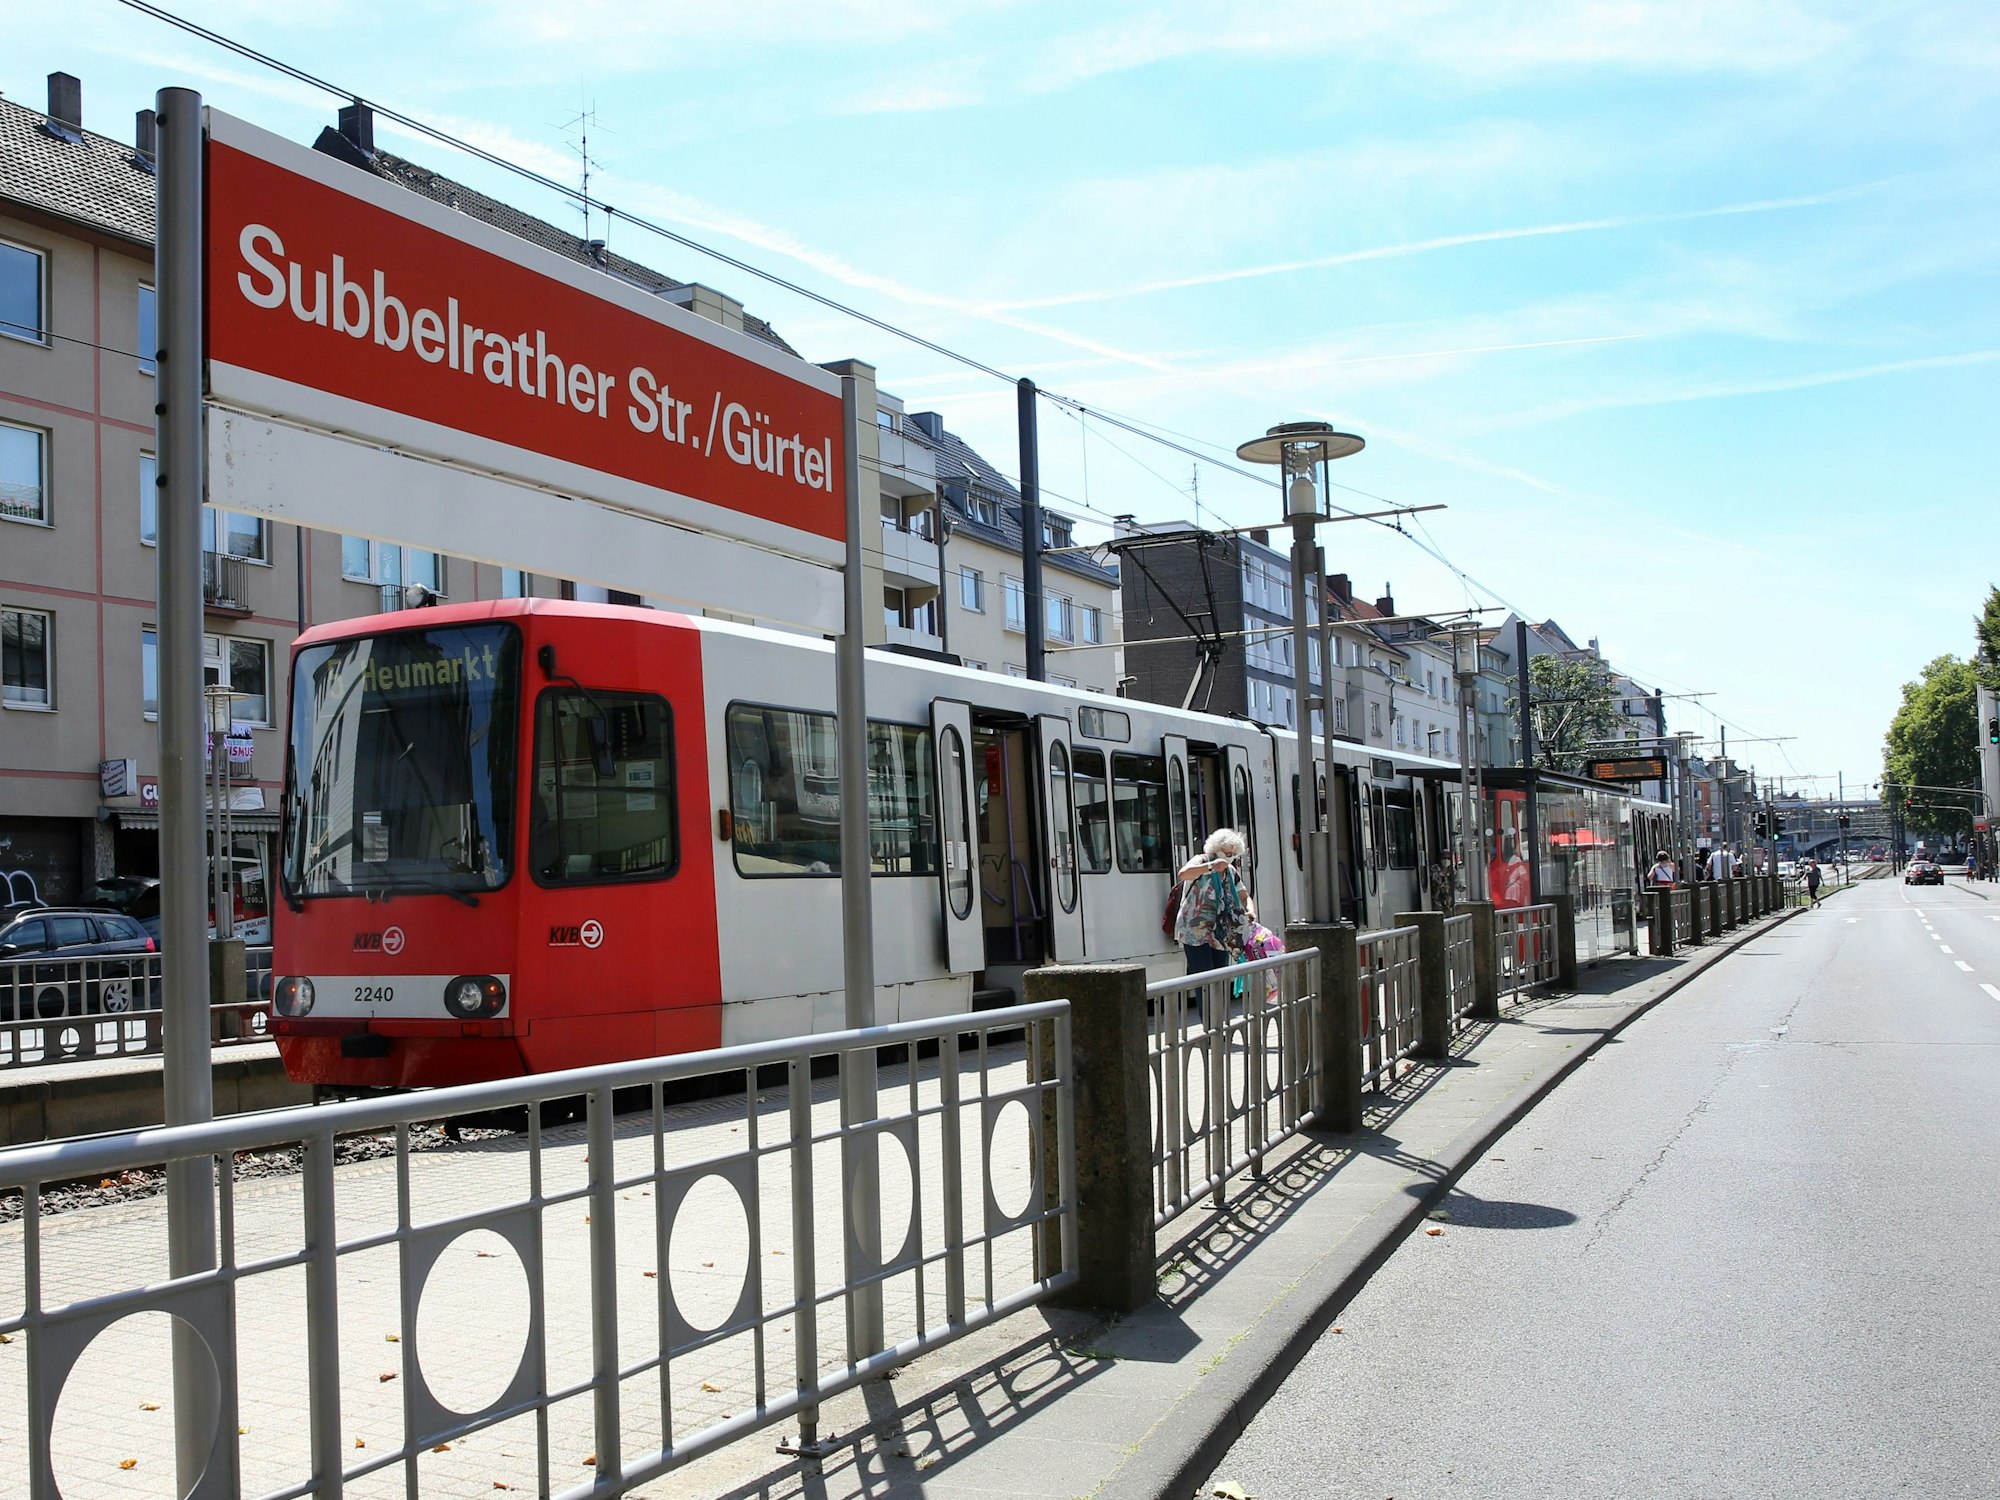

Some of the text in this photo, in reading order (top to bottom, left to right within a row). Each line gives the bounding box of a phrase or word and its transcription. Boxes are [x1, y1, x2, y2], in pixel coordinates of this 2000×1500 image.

[236, 222, 616, 420] Subbelrather
[360, 644, 496, 692] Heumarkt
[353, 932, 382, 949] KVB
[549, 926, 580, 943] KVB
[354, 986, 394, 1002] 2240
